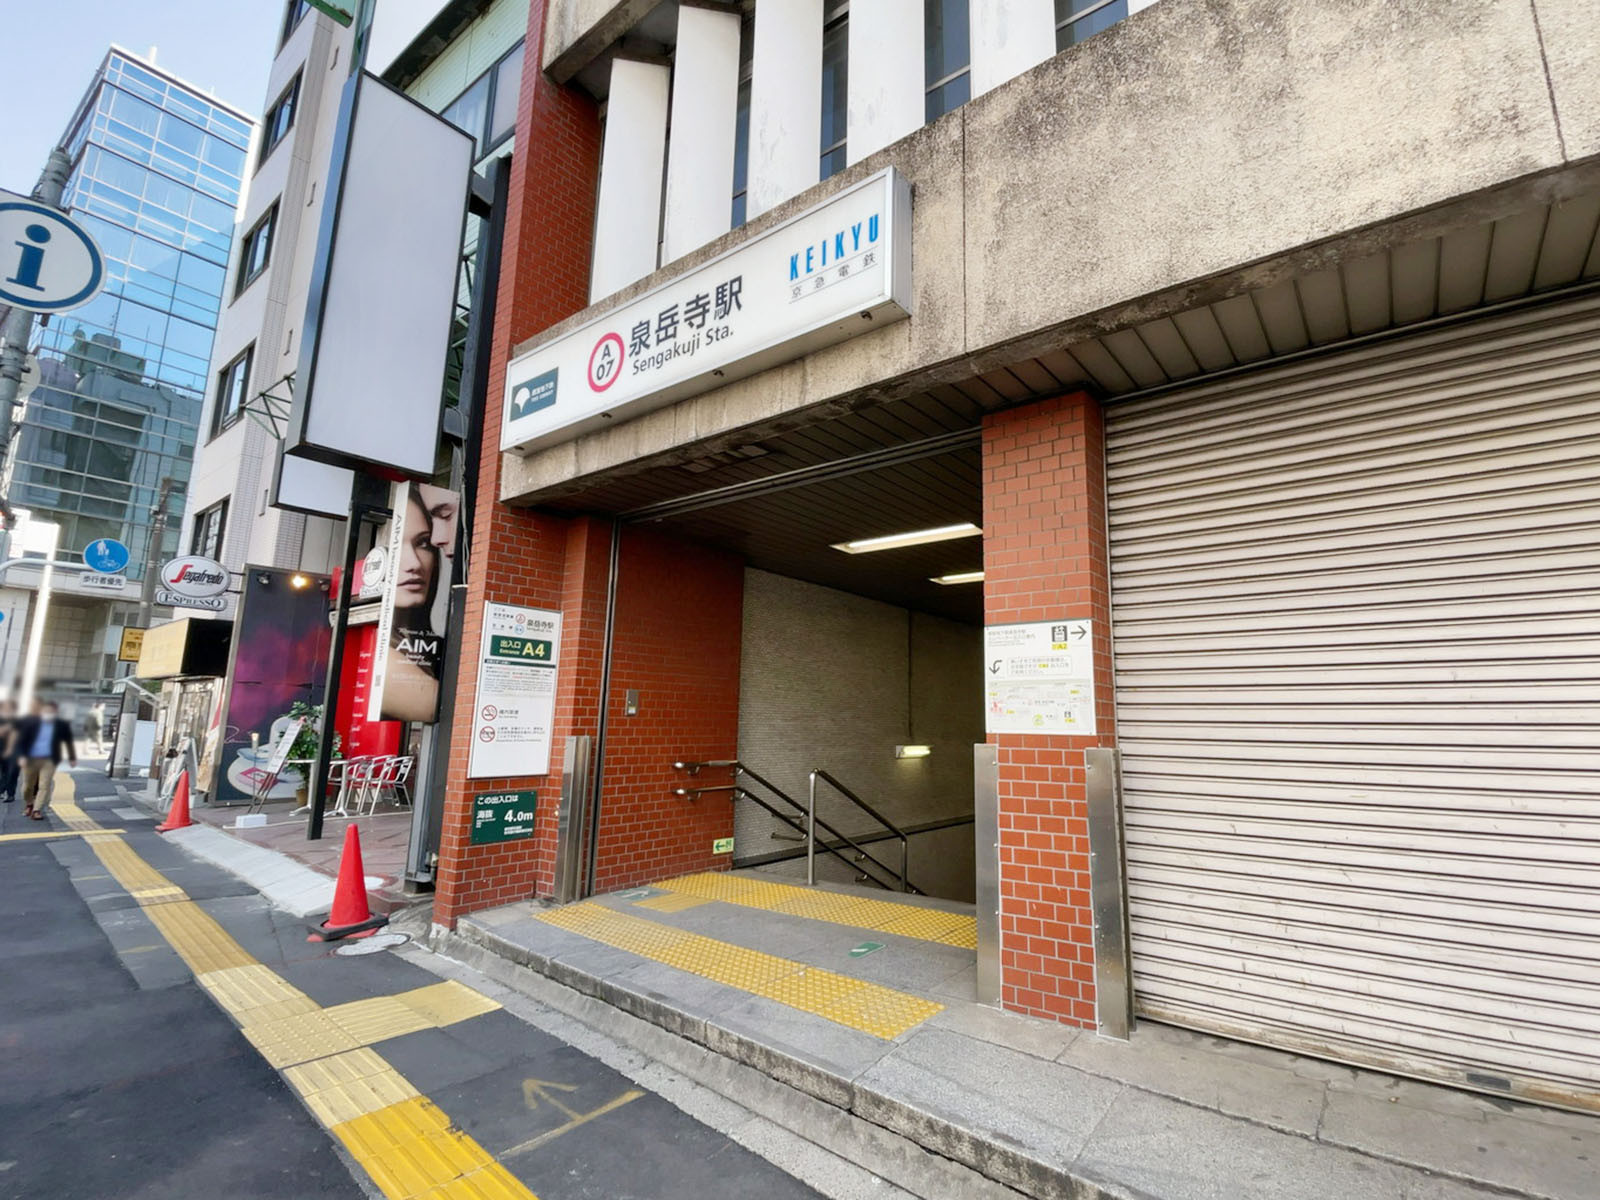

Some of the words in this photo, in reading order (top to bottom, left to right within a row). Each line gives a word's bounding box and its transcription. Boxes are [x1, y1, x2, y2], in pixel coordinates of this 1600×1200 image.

[790, 213, 879, 281] KEIKYU
[792, 252, 876, 299] 京急電鉄
[629, 275, 742, 358] 泉岳寺駅
[601, 344, 611, 361] A
[633, 333, 701, 376] Sengakuji
[705, 325, 734, 346] Sta.
[596, 359, 614, 381] 07
[393, 513, 402, 547] AIM
[83, 575, 123, 586] 歩行者優先
[170, 564, 224, 586] Segafredo
[165, 594, 221, 608] ESPRESSO
[396, 639, 437, 654] AIM
[500, 640, 521, 649] 出入口
[522, 642, 545, 657] A4
[477, 794, 519, 805] この出入口は
[504, 809, 534, 822] 4.0m
